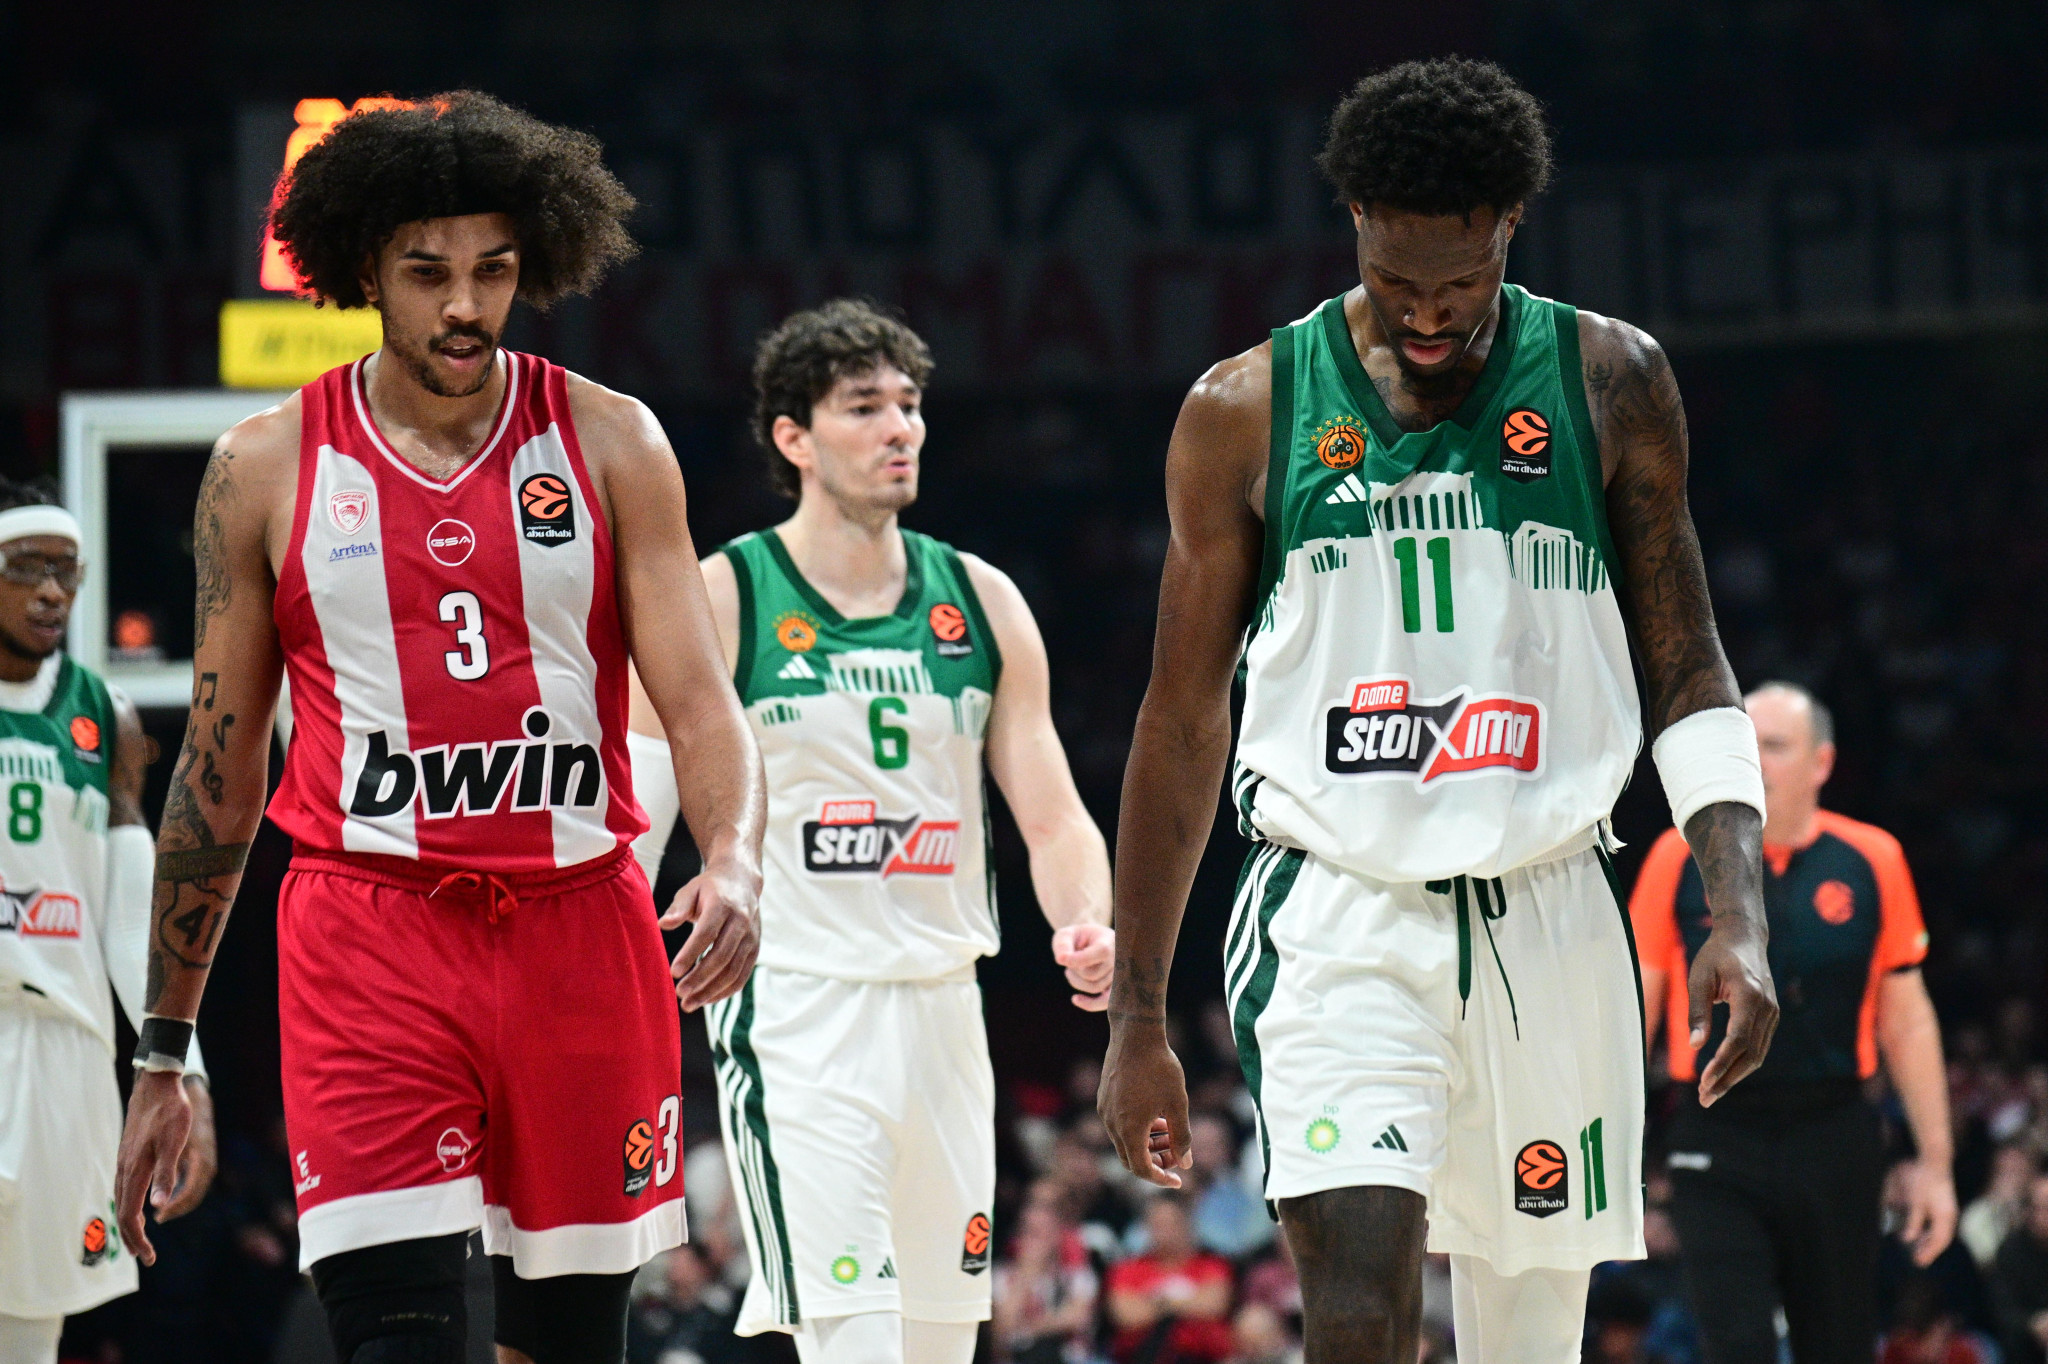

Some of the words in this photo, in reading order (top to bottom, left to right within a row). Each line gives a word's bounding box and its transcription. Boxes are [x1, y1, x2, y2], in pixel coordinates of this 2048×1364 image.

[1502, 463, 1520, 473] abu
[1520, 465, 1548, 475] dhabi
[430, 535, 472, 548] GSA
[526, 529, 544, 538] abu
[545, 529, 572, 538] dhabi
[1393, 536, 1455, 633] 11
[438, 590, 490, 682] 3
[1356, 684, 1404, 711] pame
[348, 705, 605, 820] bwin
[868, 696, 910, 770] 6
[8, 781, 43, 843] 8
[655, 1093, 680, 1188] 3
[1322, 1103, 1340, 1115] bp
[1580, 1116, 1608, 1221] 11
